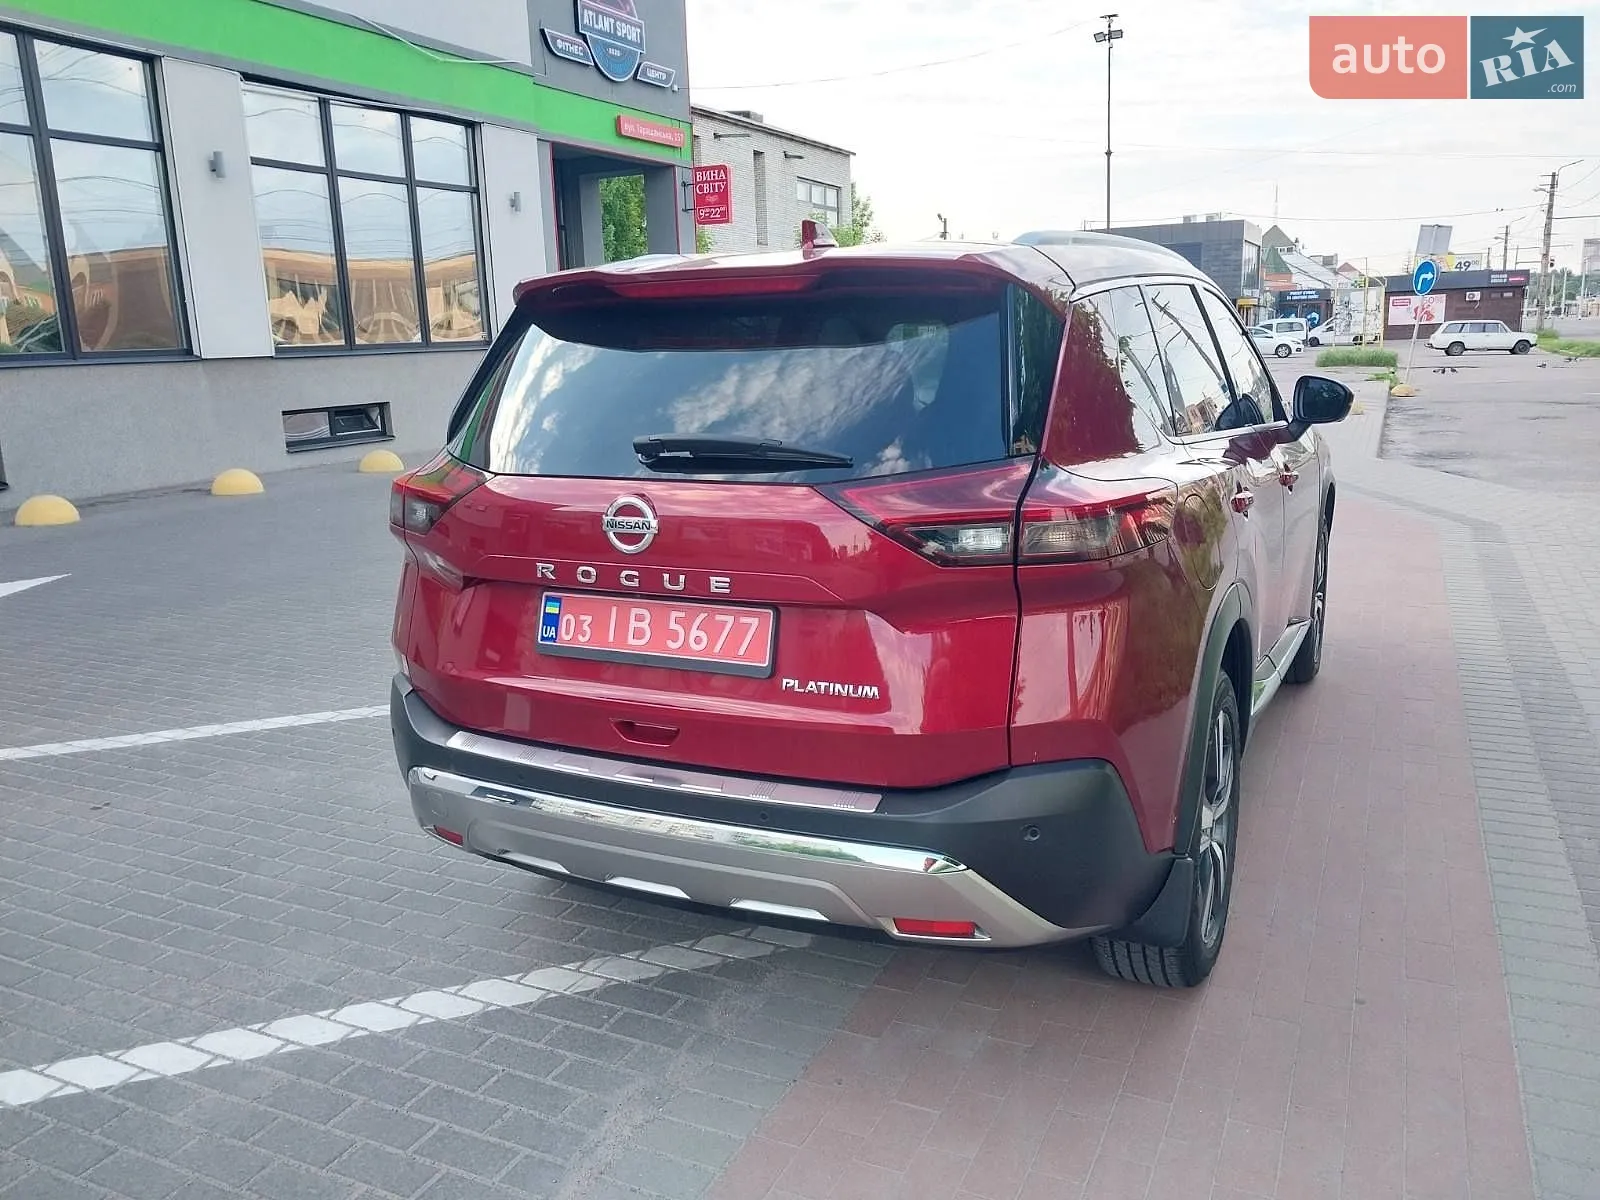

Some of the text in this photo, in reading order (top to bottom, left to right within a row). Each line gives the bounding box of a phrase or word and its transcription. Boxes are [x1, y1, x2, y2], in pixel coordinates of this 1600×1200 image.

[583, 9, 641, 43] ATLANT SPORT
[556, 39, 583, 56] ФІТНЕС
[646, 67, 667, 81] ЦЕНТР
[696, 169, 726, 182] ВИНА
[696, 181, 727, 195] СВІТУ
[606, 519, 651, 531] NISSAN
[536, 562, 731, 594] ROGUE
[542, 605, 760, 656] UA 03 IB 5677
[782, 678, 880, 700] PLATINUM
